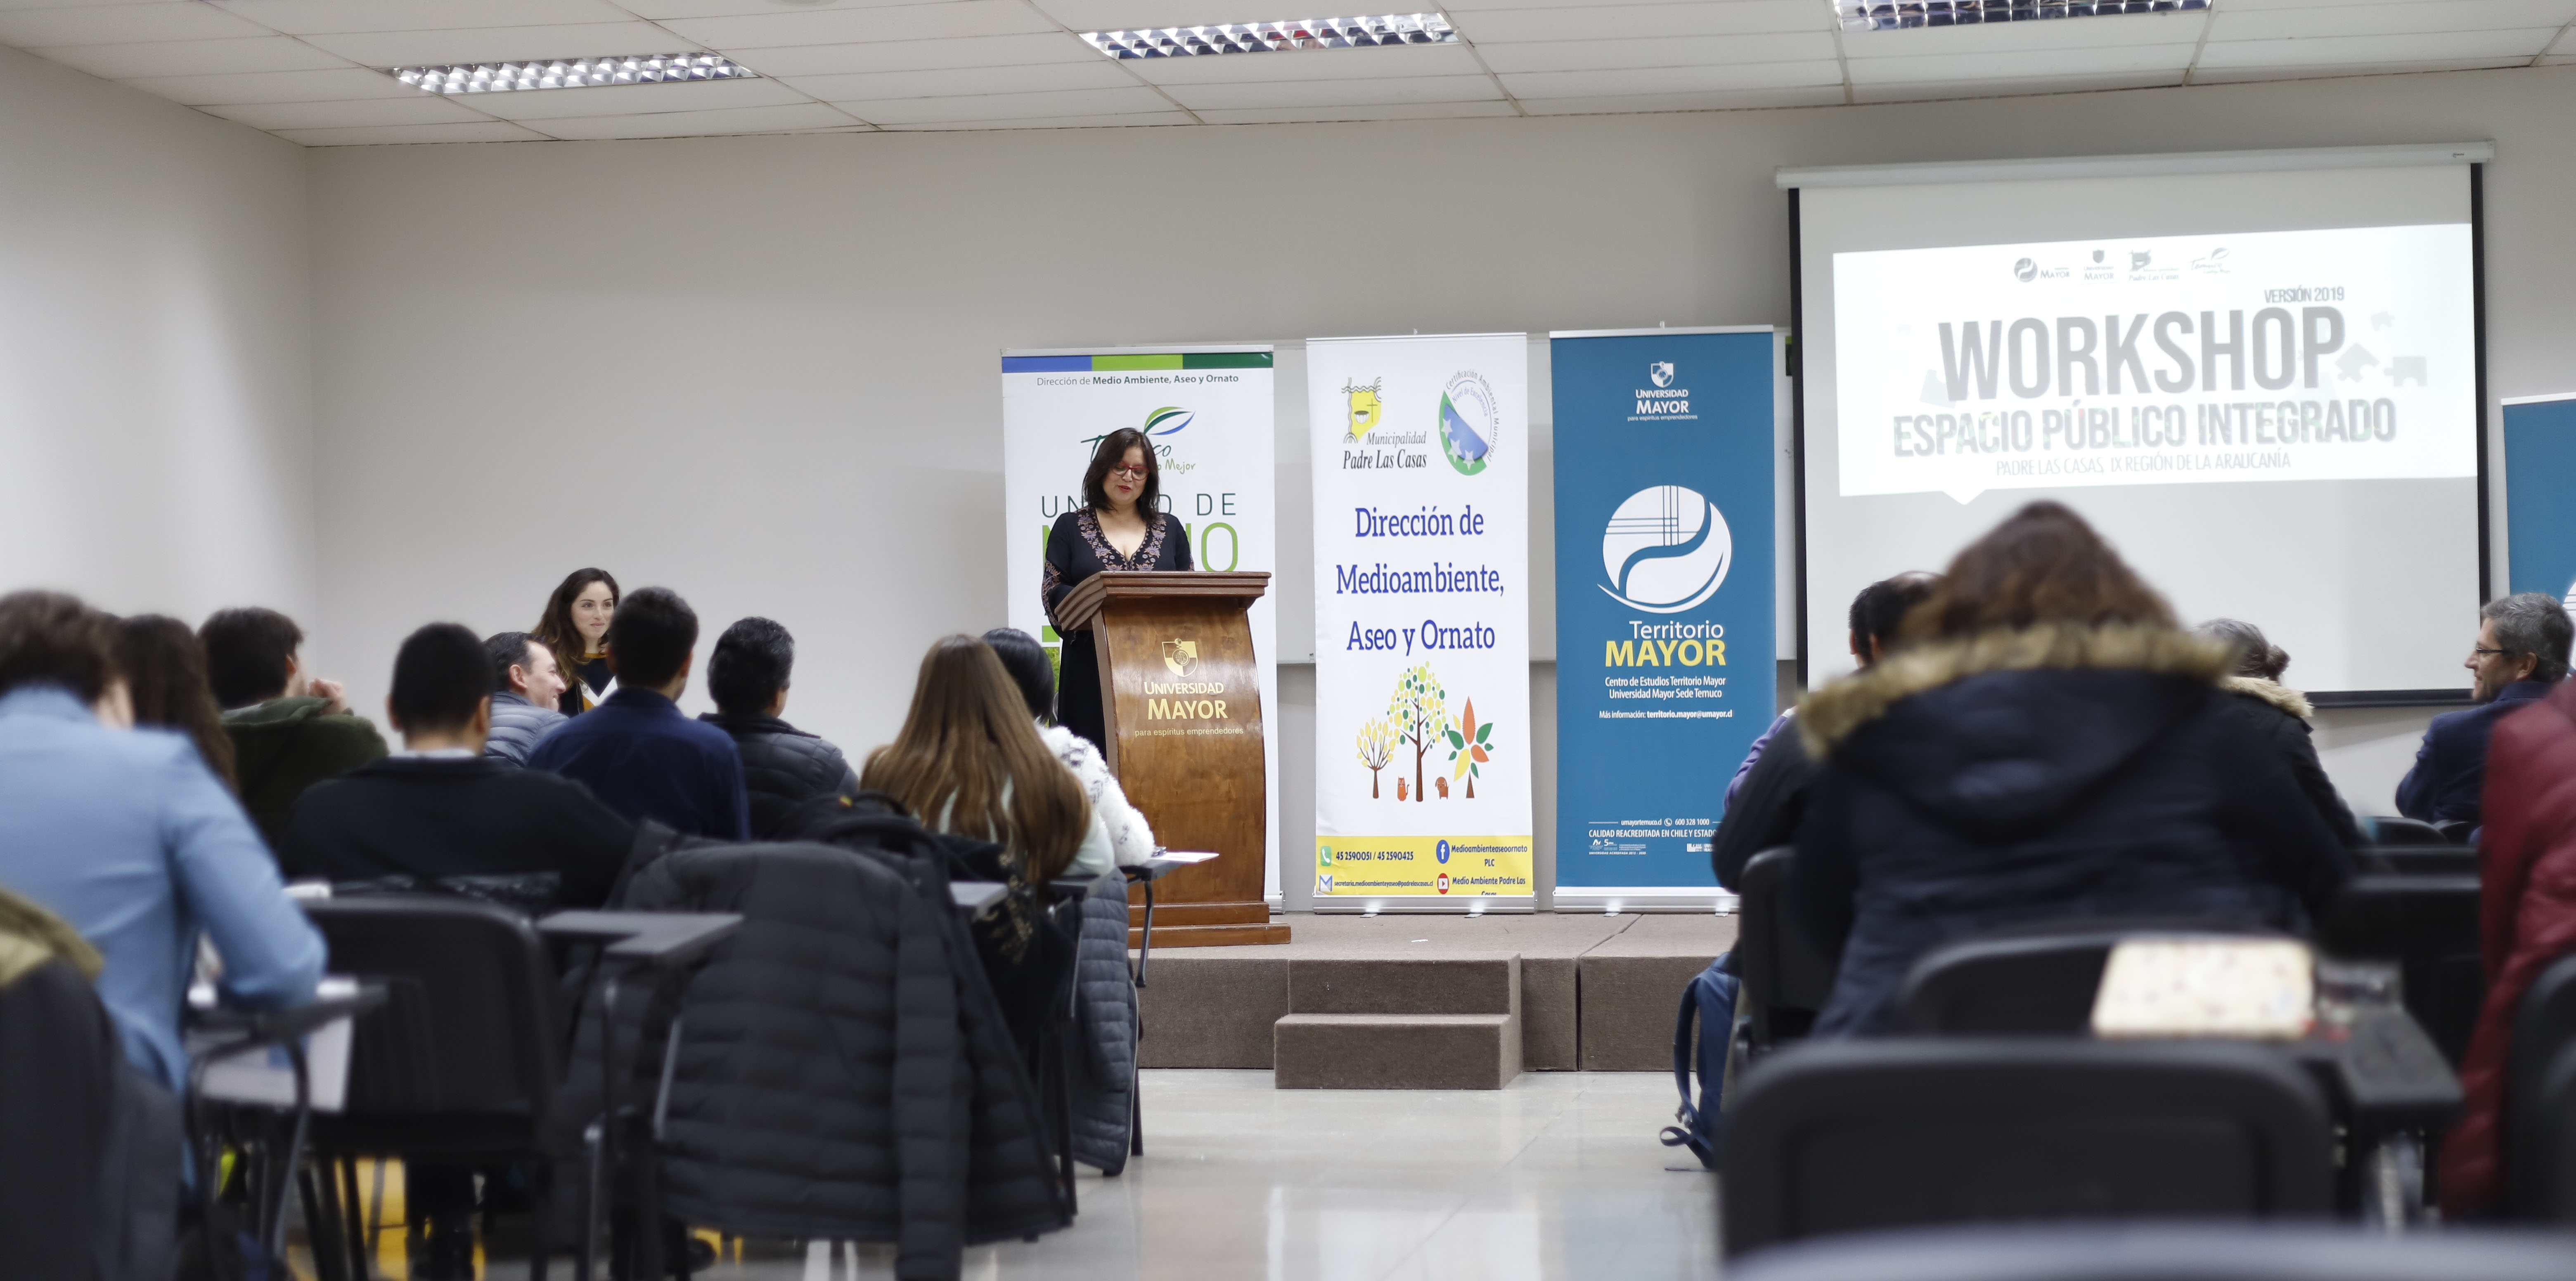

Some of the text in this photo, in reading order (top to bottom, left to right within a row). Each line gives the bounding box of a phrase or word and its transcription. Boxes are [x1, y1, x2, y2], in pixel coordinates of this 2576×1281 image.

[2040, 269, 2070, 279] MAYOR
[2264, 284, 2345, 303] VERSIÓN 2019
[1937, 305, 2346, 402] WORKSHOP
[1037, 376, 1077, 386] Dirección
[1079, 376, 1091, 385] de
[1093, 376, 1122, 385] Medio
[1124, 375, 1172, 385] Ambiente,
[1174, 375, 1196, 383] Aseo
[1206, 374, 1239, 383] Ornato
[1452, 388, 1463, 404] Nivel
[1635, 389, 1689, 399] UNIVERSIDAD
[1636, 400, 1689, 414] MAYOR
[1446, 369, 1499, 462] Certificación Ambiental Municipal
[1893, 397, 2397, 458] ESPACIO PÚBLICO INTEGRADO
[1367, 431, 1427, 448] Municipalidad
[1165, 458, 1196, 475] Mejor
[1343, 449, 1427, 469] Padre Las Casas
[1996, 447, 2292, 475] PADRE LAS CASAS, IX REGIÓN DE LA ARAUCANÍA
[1197, 493, 1236, 516] DE
[1355, 504, 1484, 537] Dirección de
[1336, 562, 1504, 597] Medioambiente,
[1347, 619, 1495, 656] Aseo y Ornato
[1629, 620, 1724, 639] Territorio
[1605, 639, 1726, 667] MAYOR
[1144, 681, 1224, 695] UNIVERSIDAD
[1605, 675, 1726, 688] Centro de Estudios Territorio Mayor
[1609, 688, 1722, 701] Universidad Mayor Sede Temuco
[1148, 699, 1229, 720] MAYOR
[1599, 709, 1733, 720] Más información: territorio.mayor@umayor.cl
[1135, 727, 1244, 738] para espíritus emprendedores
[1589, 830, 1615, 838] CALIDAD
[1616, 829, 1660, 838] REACREDITADA
[1661, 829, 1670, 837] EN
[1671, 829, 1688, 837] CHILE
[1688, 829, 1693, 837] Y
[1336, 851, 1413, 860] 45 2590051 / 45 2590425
[1451, 844, 1527, 853] Medioambienteaseoornato
[1485, 858, 1495, 867] PLC
[1452, 876, 1469, 885] Medio
[1470, 876, 1498, 885] Ambiente
